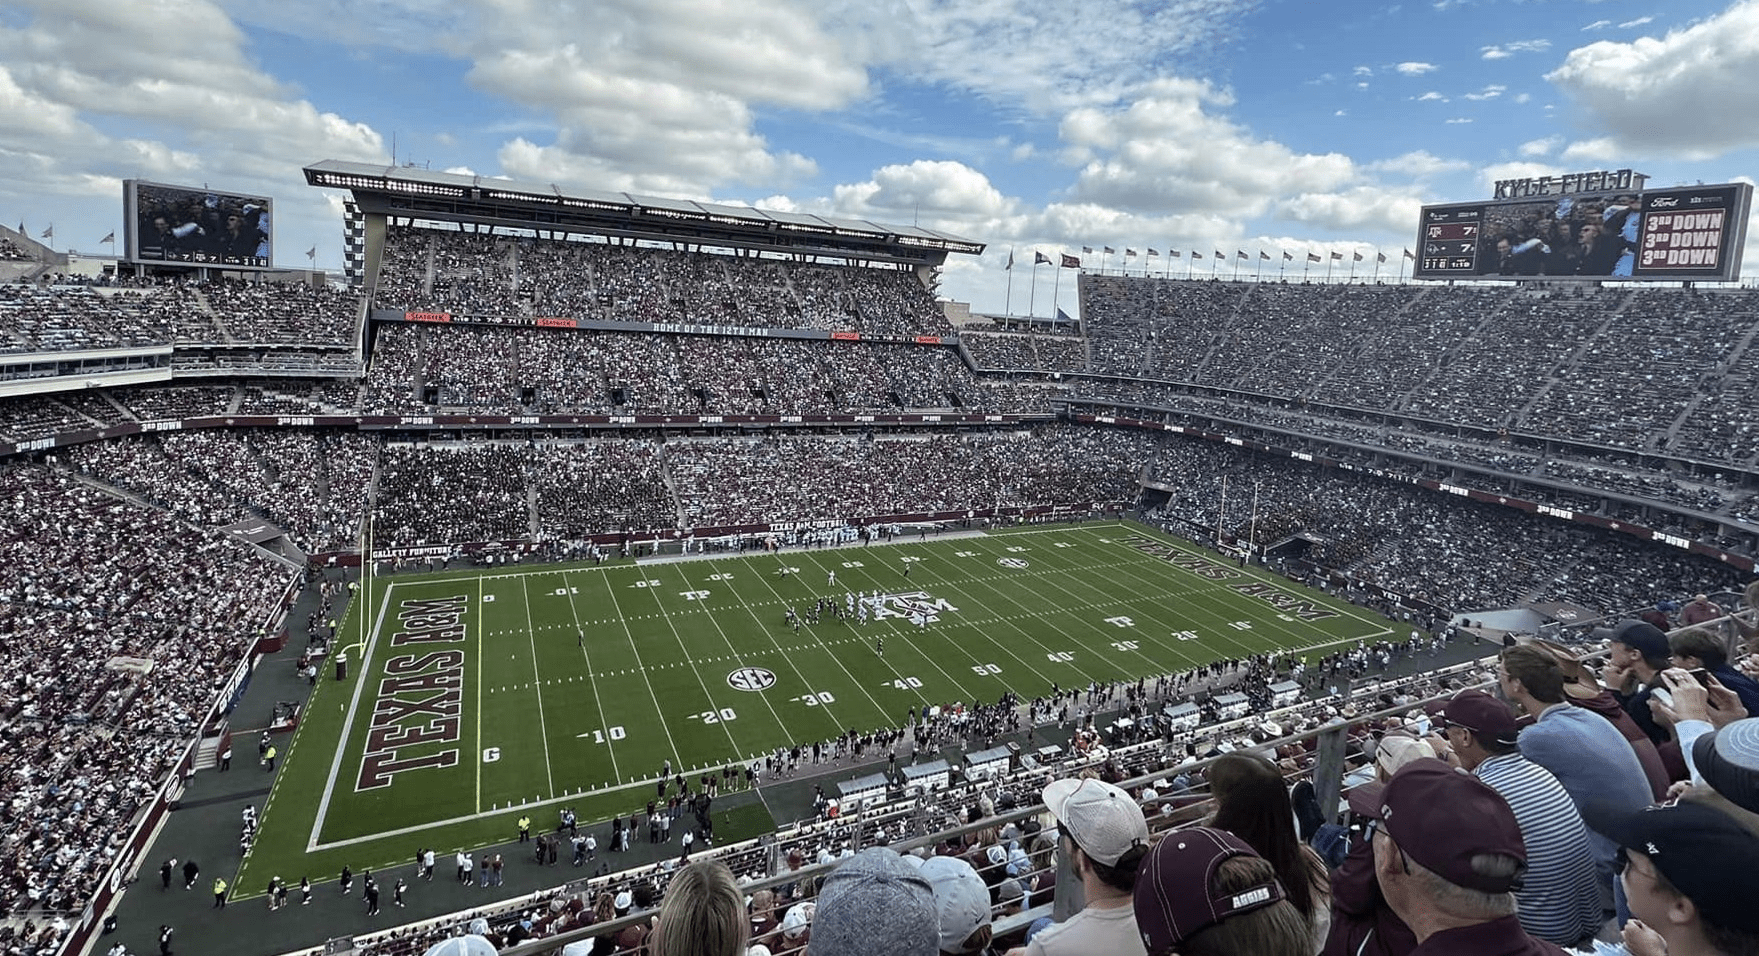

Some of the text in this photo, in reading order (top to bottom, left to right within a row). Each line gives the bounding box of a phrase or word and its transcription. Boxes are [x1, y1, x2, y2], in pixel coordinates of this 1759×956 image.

[1493, 169, 1632, 199] KYLE FIELD
[1650, 197, 1679, 207] Ford
[1648, 213, 1722, 231] 3RD DOWN
[1463, 226, 1473, 236] 7
[1645, 231, 1719, 248] 3RD DOWN
[1461, 244, 1471, 252] 7
[1642, 249, 1716, 265] 3RD DOWN
[653, 323, 768, 336] HOME OF THE 12TH MAN
[156, 421, 182, 431] DOWN
[291, 417, 314, 425] DOWN
[31, 438, 55, 450] DOWN
[768, 522, 794, 531] TEXAS
[1382, 590, 1401, 602] YETI
[1228, 621, 1252, 630] 10
[1171, 630, 1198, 641] 20
[1110, 641, 1139, 651] 30
[1047, 651, 1074, 663] 40
[970, 663, 1002, 676] 50
[731, 668, 773, 690] SEC
[894, 676, 924, 690] 40
[354, 594, 468, 792] TEXAS A&M
[801, 691, 836, 707] 30
[700, 707, 737, 724] 20
[592, 726, 627, 744] 10
[483, 747, 501, 762] G
[1232, 887, 1270, 909] AGGIES
